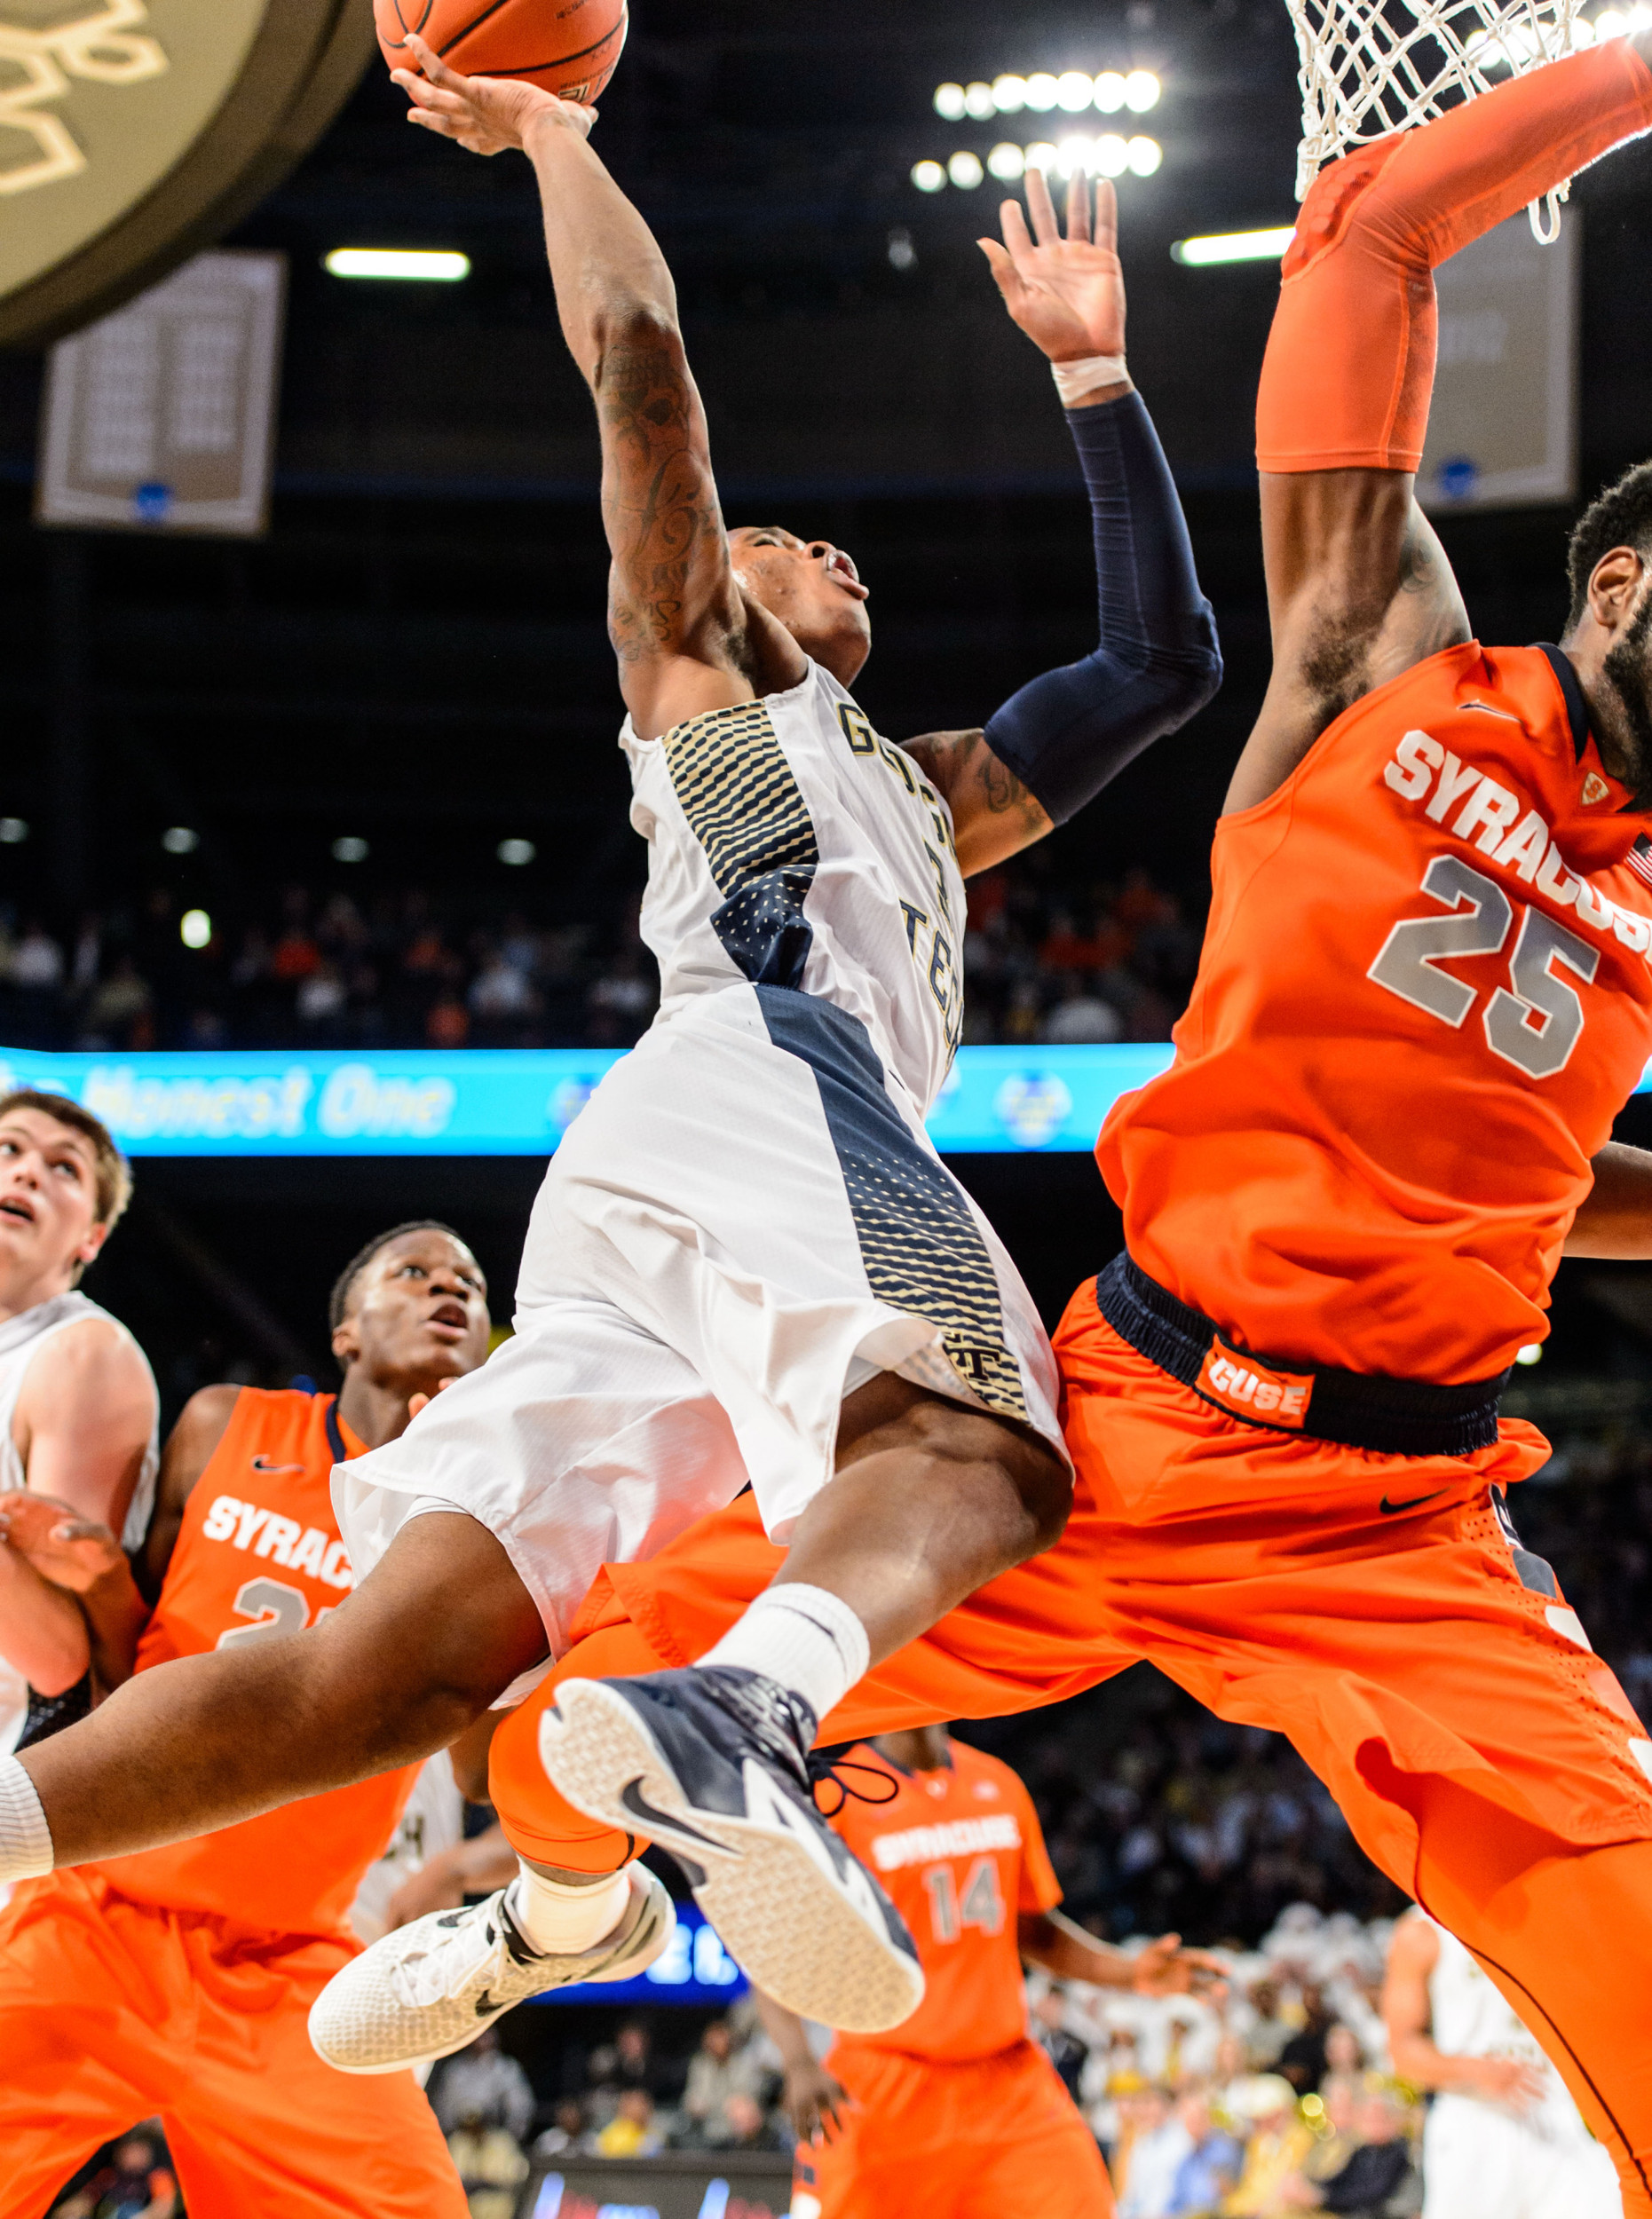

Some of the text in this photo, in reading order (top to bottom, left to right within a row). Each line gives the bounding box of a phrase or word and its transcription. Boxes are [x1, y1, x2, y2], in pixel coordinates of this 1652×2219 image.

[1384, 729, 1652, 960] SYRACUS
[1367, 854, 1601, 1079] 25
[319, 1063, 456, 1138] One
[1208, 1356, 1307, 1415] CUSE
[202, 1494, 356, 1591] SYRAC
[215, 1576, 336, 1652] 2
[922, 1855, 1007, 1944] 14
